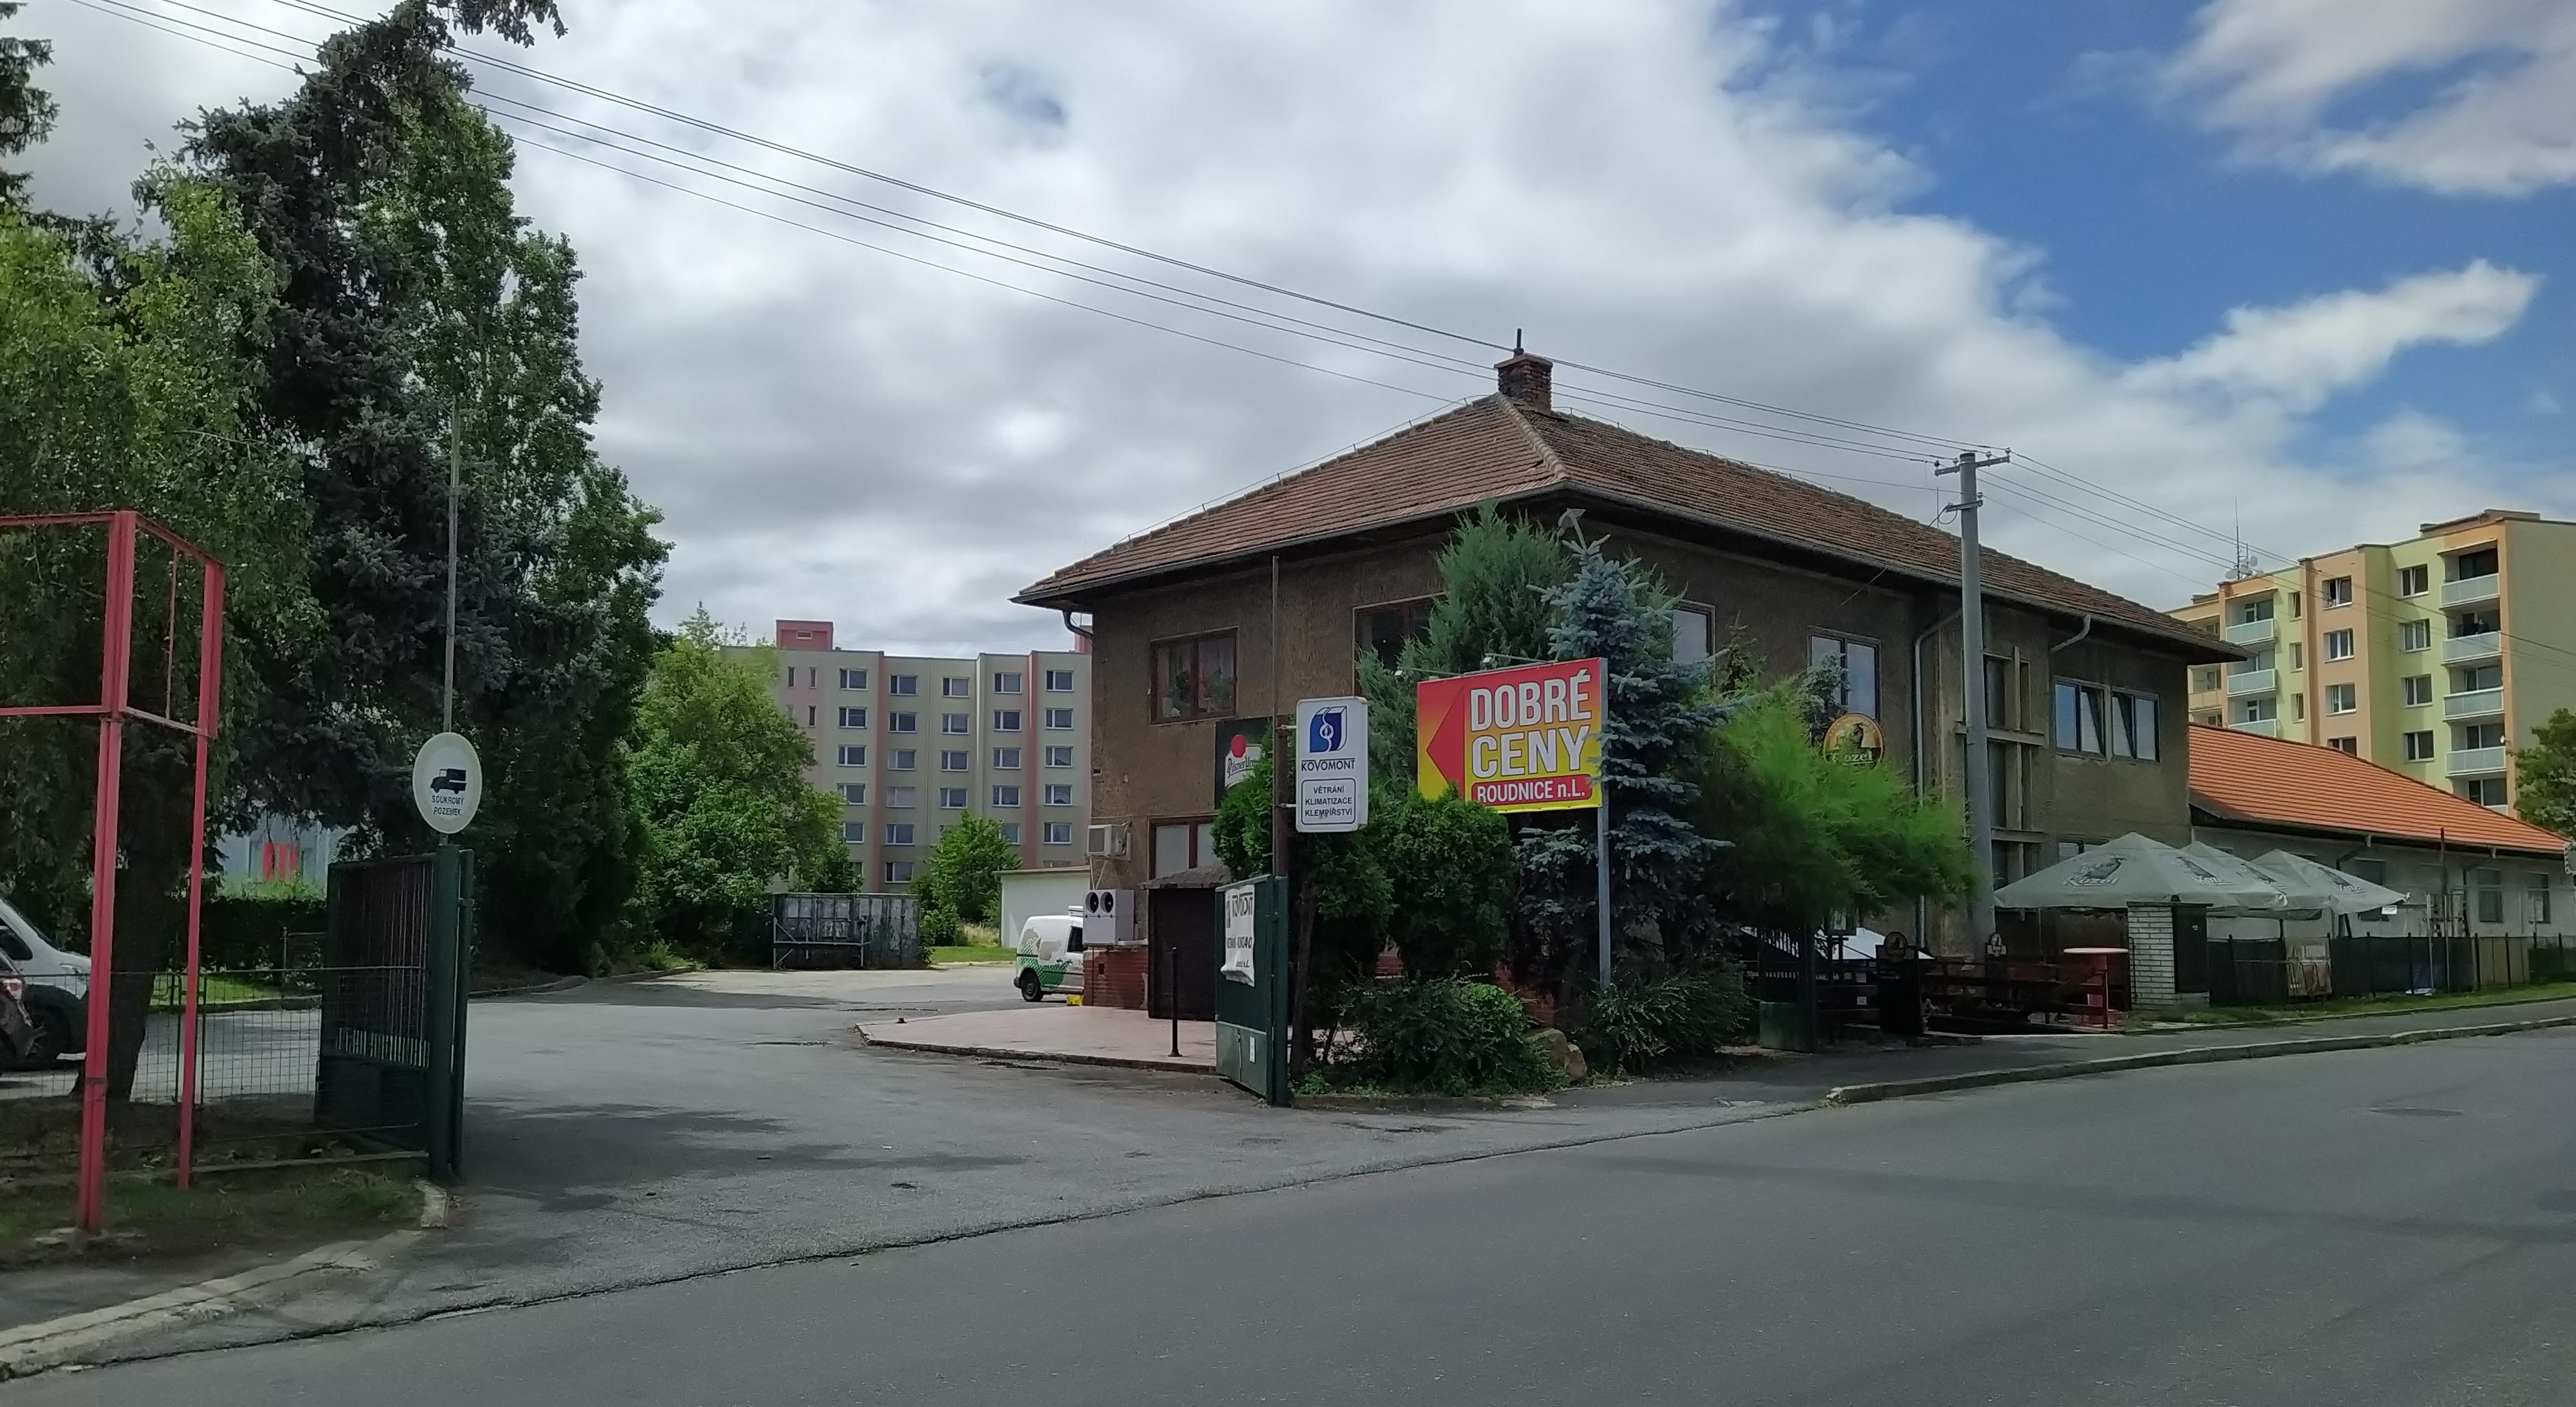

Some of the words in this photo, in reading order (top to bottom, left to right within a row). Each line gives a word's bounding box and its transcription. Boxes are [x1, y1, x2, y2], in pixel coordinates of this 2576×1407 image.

[1471, 668, 1592, 732] DOBRÉ
[1471, 725, 1590, 778] CENY
[1301, 758, 1356, 772] KOVOMONT
[1313, 785, 1345, 794] VĚTRÁNÍ
[1477, 780, 1554, 803] ROUDNICE
[1557, 778, 1585, 798] n.L.
[1305, 797, 1353, 806] KLIMATIZACE
[433, 807, 461, 816] POZEMEK
[1304, 807, 1353, 817] KLEMPÍŘSTVÍ
